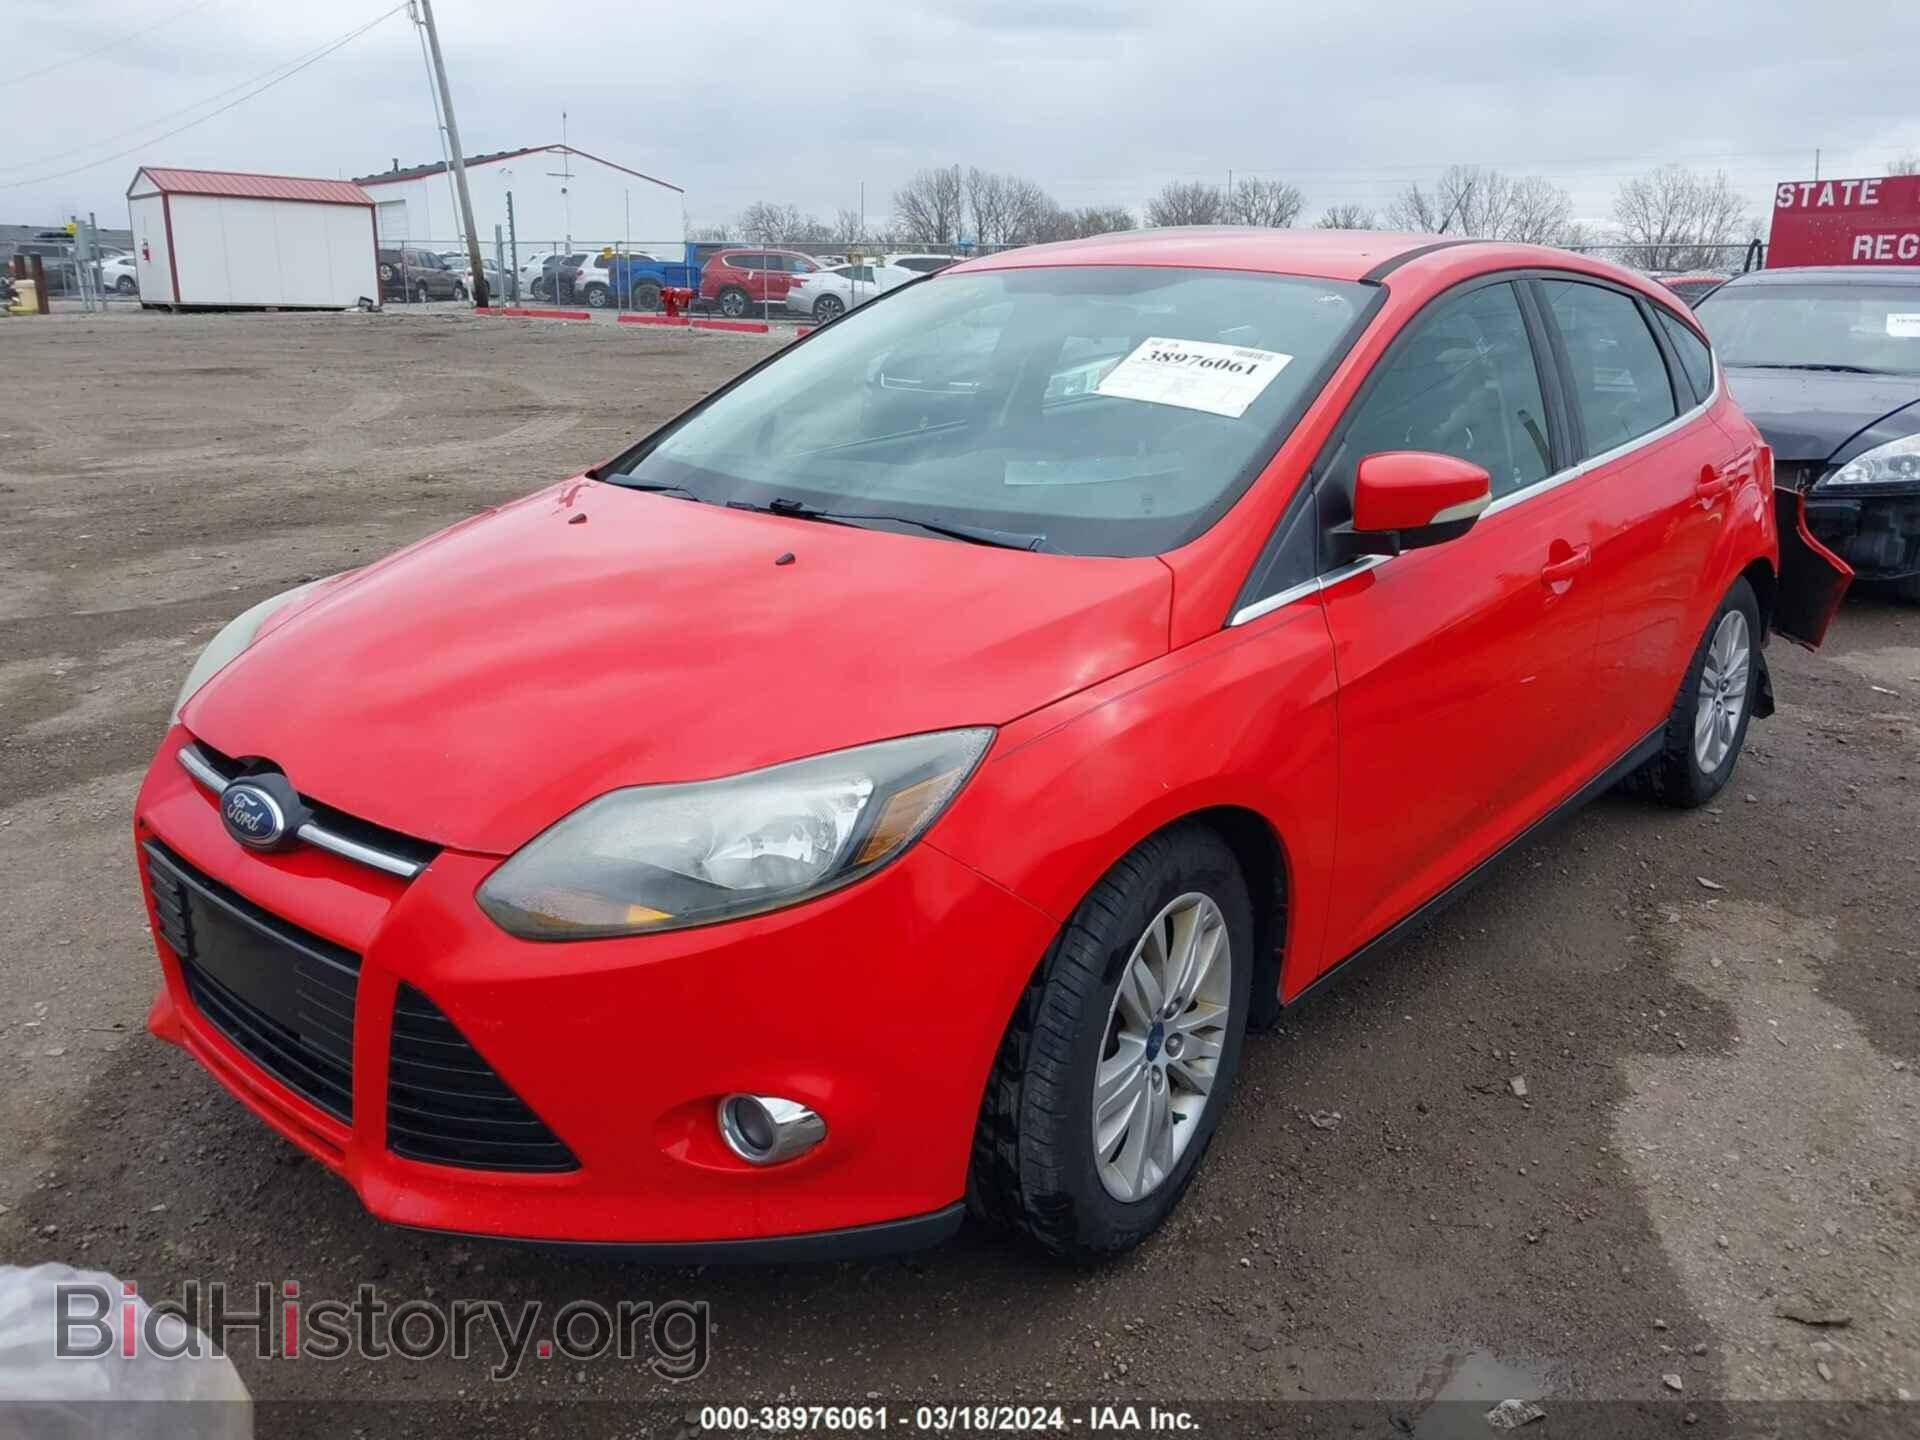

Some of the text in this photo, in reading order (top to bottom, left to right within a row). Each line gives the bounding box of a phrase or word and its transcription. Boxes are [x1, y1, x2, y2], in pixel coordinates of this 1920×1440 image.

[1776, 179, 1882, 208] STATE
[1852, 233, 1920, 260] REG
[1142, 350, 1258, 375] 38976061
[227, 793, 264, 831] Ford
